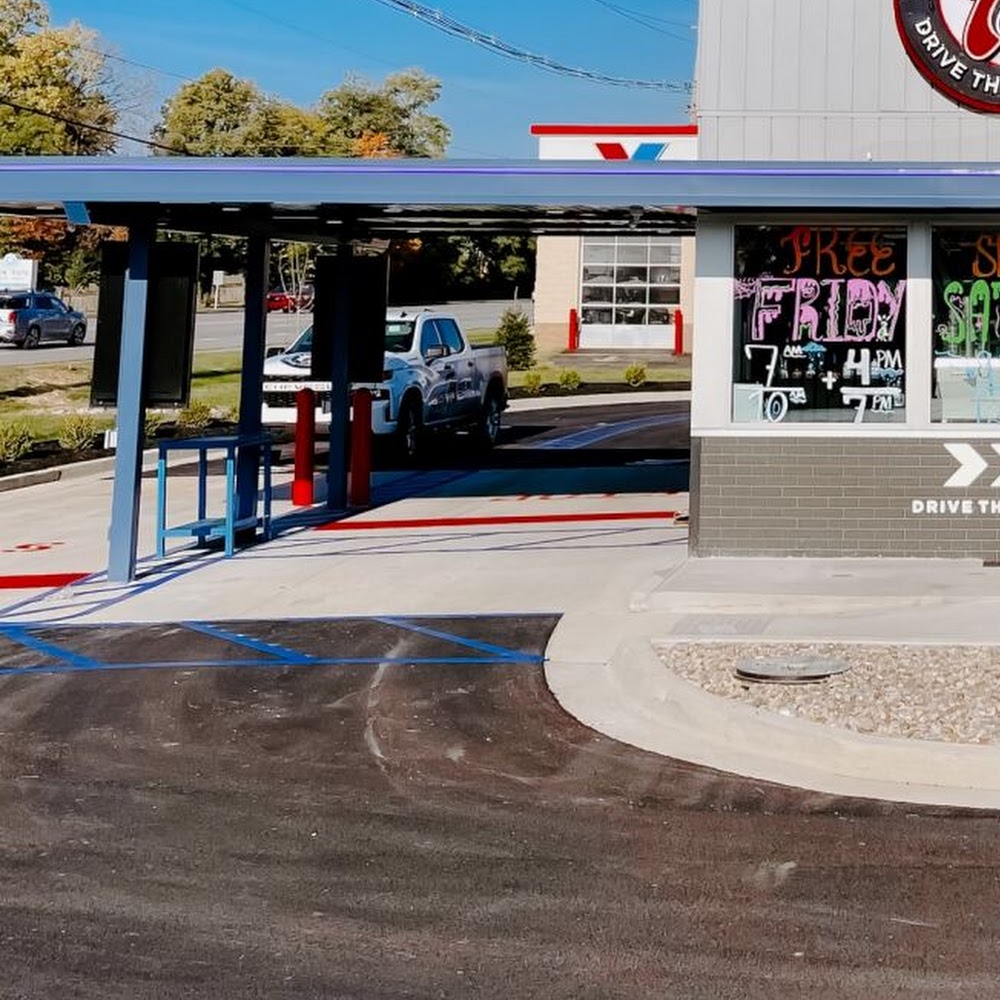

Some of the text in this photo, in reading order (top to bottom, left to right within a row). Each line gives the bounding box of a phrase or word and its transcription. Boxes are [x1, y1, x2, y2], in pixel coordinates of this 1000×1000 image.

[915, 17, 967, 81] DRIVE
[745, 344, 778, 388] 7
[844, 349, 870, 385] 4
[876, 349, 902, 368] PM
[843, 394, 866, 423] 7
[870, 395, 893, 413] PM
[912, 499, 973, 514] DRIVE
